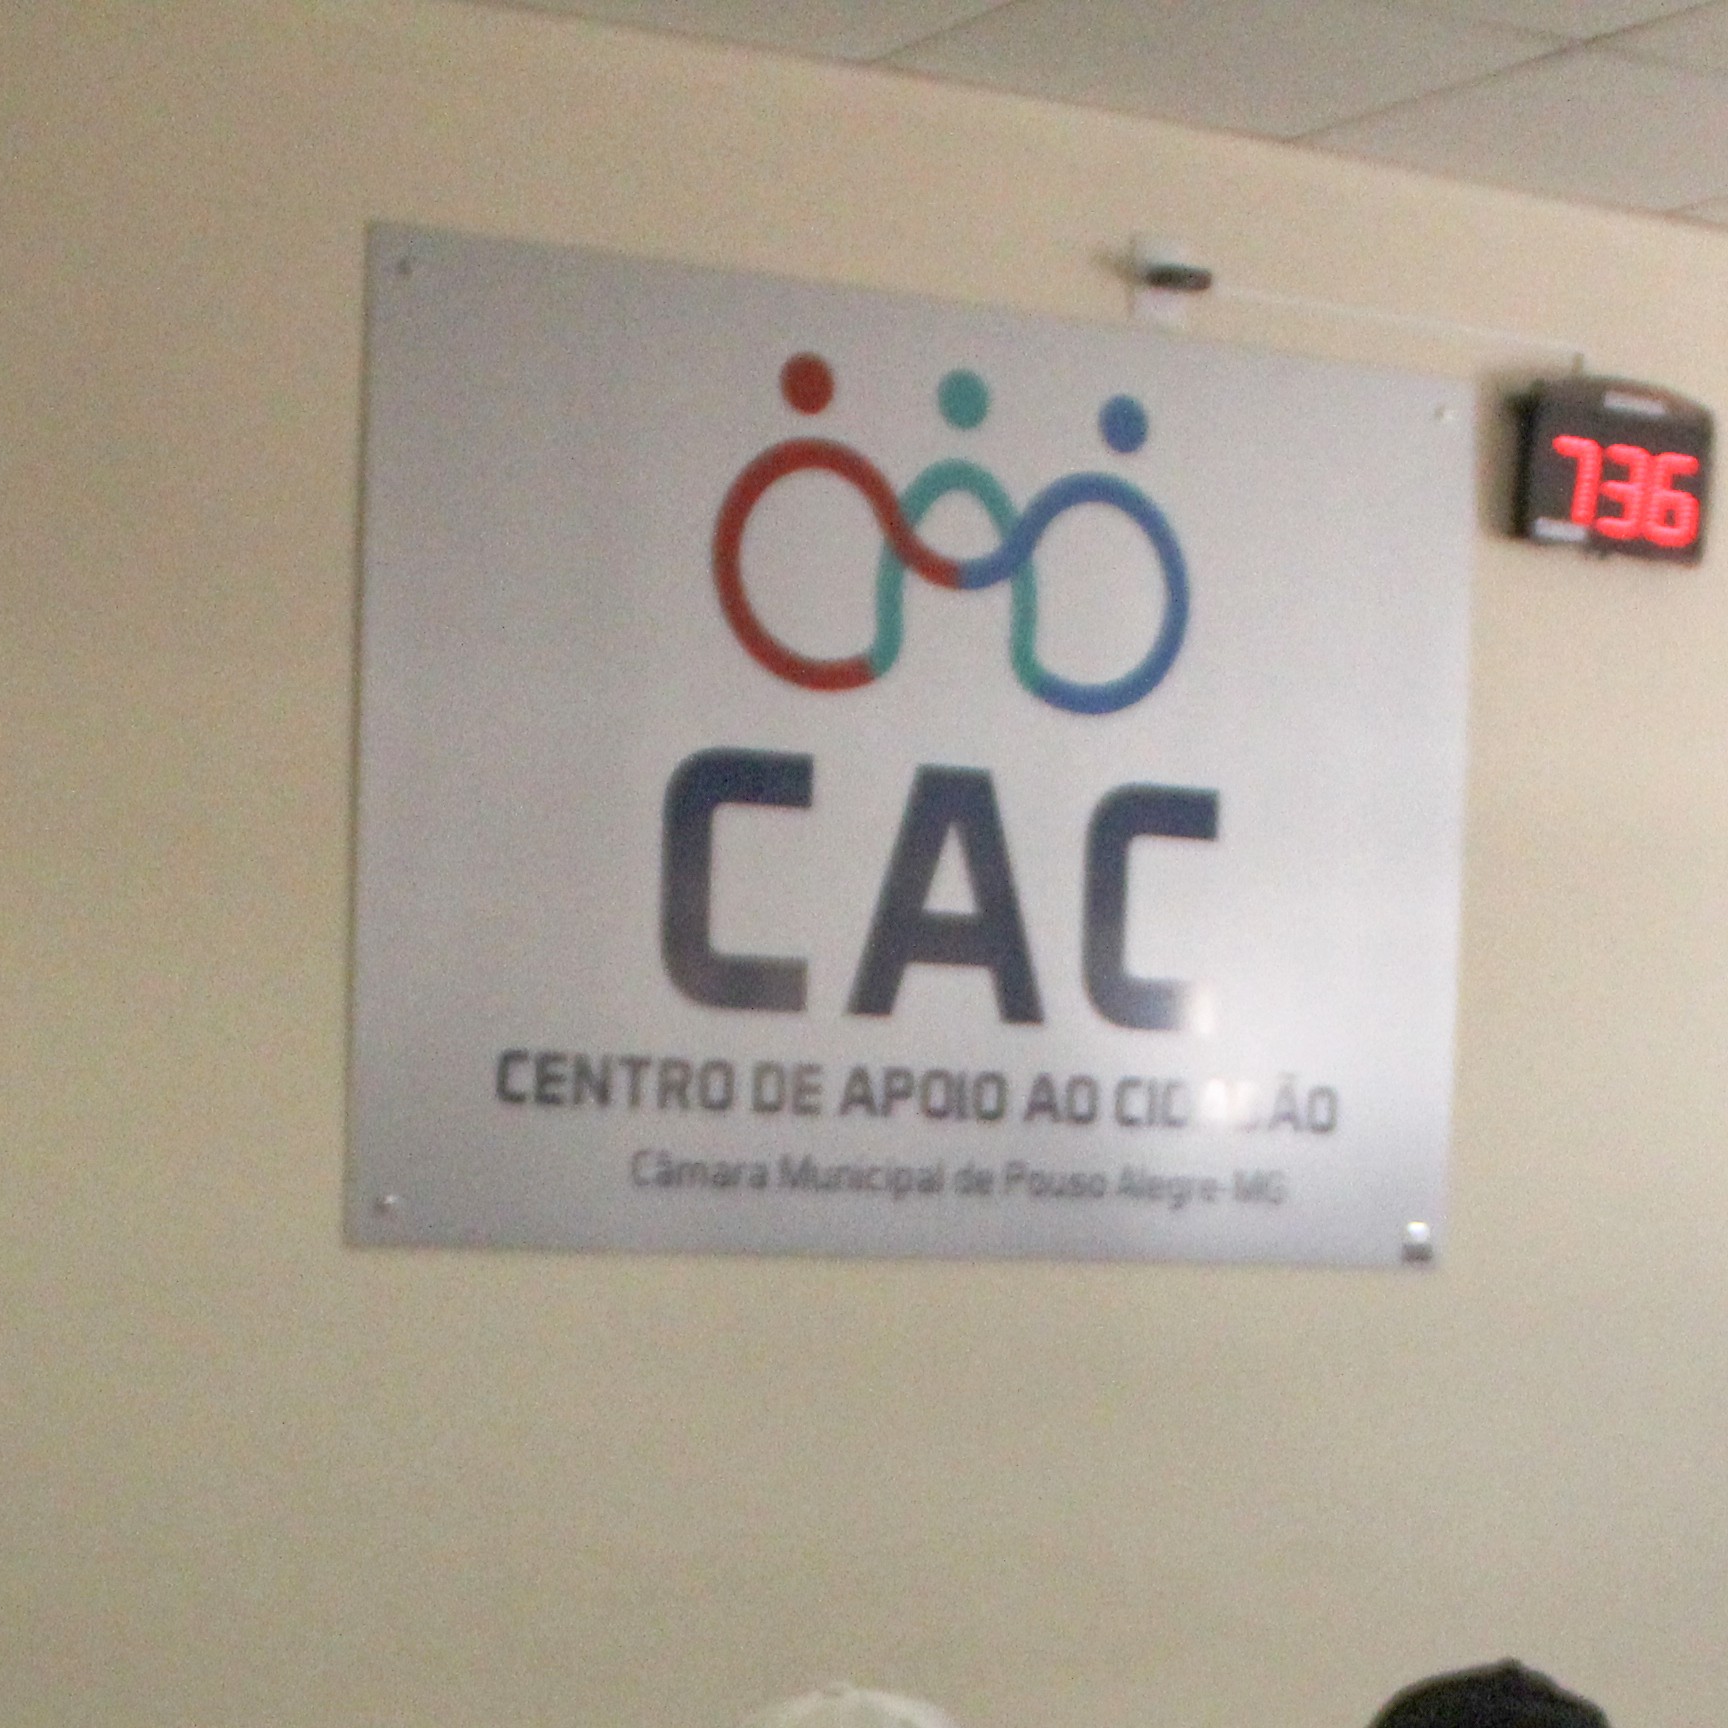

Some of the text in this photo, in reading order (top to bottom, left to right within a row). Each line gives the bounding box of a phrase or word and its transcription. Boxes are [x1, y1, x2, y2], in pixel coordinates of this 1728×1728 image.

[1551, 433, 1700, 548] 736
[658, 745, 1220, 1032] CAC
[495, 1048, 1338, 1134] CENTRO DE APOIO AO CIDÃO
[631, 1148, 770, 1188] Câmara
[777, 1152, 944, 1200] Municipal
[954, 1164, 994, 1195] de
[1002, 1158, 1108, 1200] Pouso
